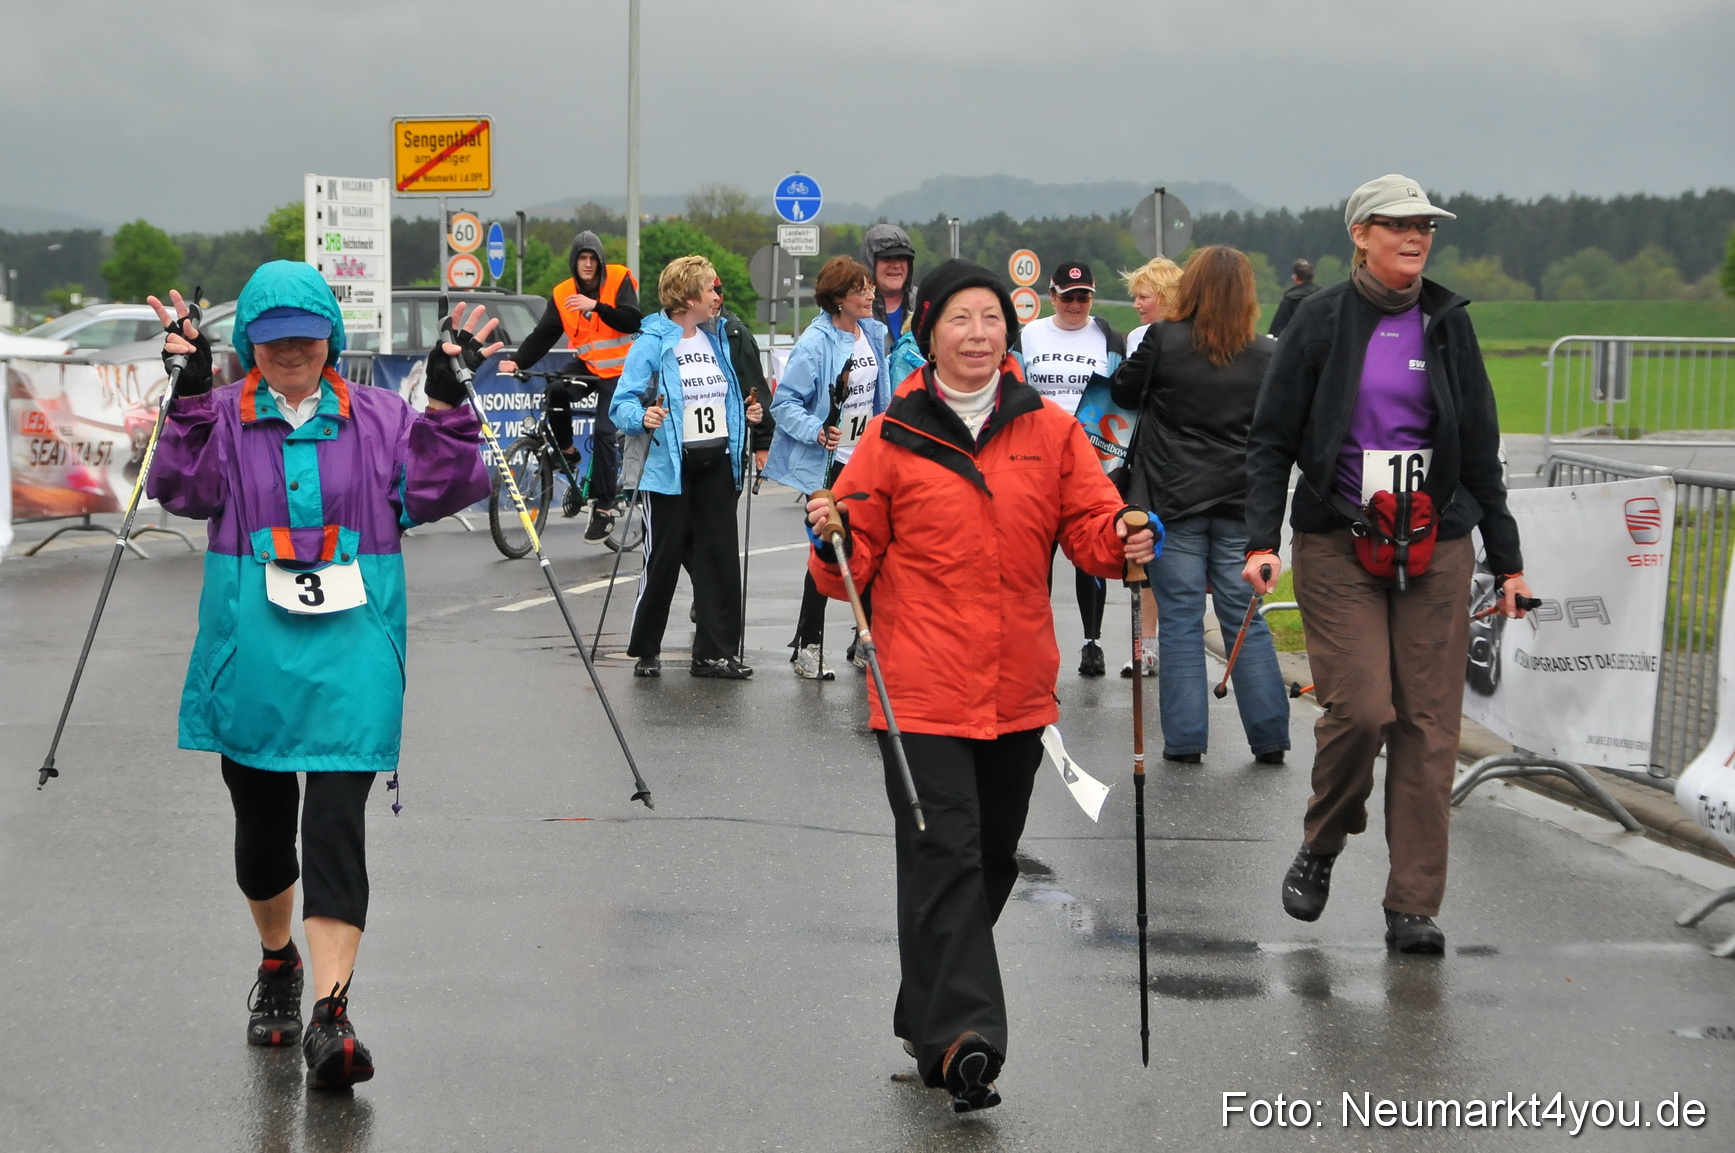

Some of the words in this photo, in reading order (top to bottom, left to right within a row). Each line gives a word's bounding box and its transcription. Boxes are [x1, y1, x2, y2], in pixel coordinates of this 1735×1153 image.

[404, 130, 481, 152] Sengenthal
[414, 155, 431, 163] am
[455, 224, 474, 241] 60
[1017, 260, 1033, 276] 60
[677, 353, 718, 366] ERGER
[850, 356, 875, 371] RGE
[1032, 353, 1097, 367] BERGER
[1408, 359, 1426, 368] SW
[682, 376, 704, 387] WER
[706, 374, 727, 385] GIRL
[1068, 374, 1090, 384] GIR
[684, 393, 698, 401] lking
[847, 383, 865, 396] WER
[694, 406, 716, 433] 13
[850, 415, 867, 441] 14
[1388, 453, 1424, 493] 16
[1627, 553, 1665, 567] SEAT
[295, 573, 325, 606] 3
[1535, 595, 1611, 628] PA
[1530, 655, 1574, 672] UPGRADE
[1575, 655, 1596, 672] IST
